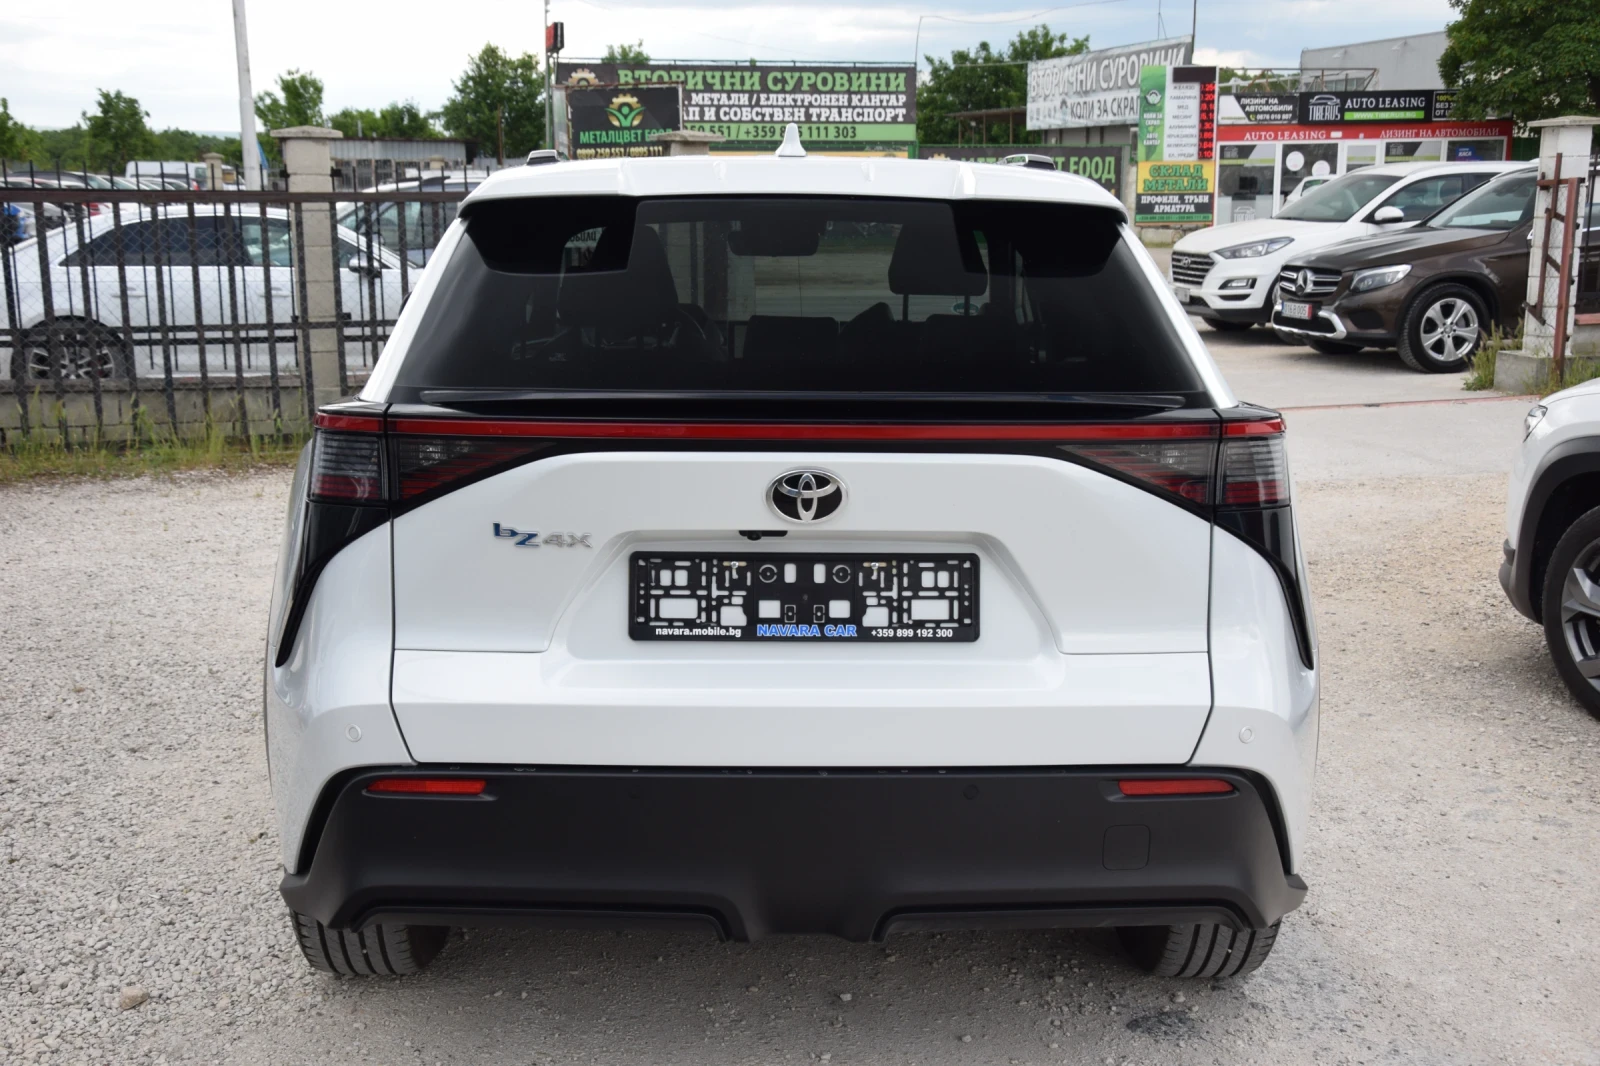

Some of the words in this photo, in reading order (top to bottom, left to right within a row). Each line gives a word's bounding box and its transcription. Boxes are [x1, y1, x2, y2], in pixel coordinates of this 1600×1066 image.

[617, 69, 761, 91] ВТОРИЧНИ
[766, 71, 907, 92] СУРОВИНИ
[1030, 61, 1097, 97] ВТОРИЧНИ
[691, 93, 749, 105] МЕТАЛИ
[751, 94, 757, 106] /
[759, 93, 849, 106] ЕЛЕКТРОНЕН
[851, 94, 907, 107] КАНТАР
[1344, 98, 1376, 109] AUTO
[1378, 97, 1426, 108] LEASING
[703, 107, 716, 121] И
[719, 107, 806, 121] СОБСТВЕН
[809, 107, 907, 122] ТРАНСПОРТ
[1070, 99, 1094, 121] КОЛИ
[1096, 100, 1109, 118] ЗА
[1308, 105, 1341, 121] TIBERUS
[579, 130, 643, 145] МЕТАЛЦВЕТ
[744, 126, 776, 139] +359
[779, 126, 803, 139] 85
[808, 126, 829, 139] 111
[834, 126, 857, 139] 303
[1244, 131, 1275, 141] AUTO
[1277, 131, 1327, 140] LEASING
[1380, 129, 1418, 138] ЛИЗИНГ
[1419, 129, 1433, 138] НА
[1435, 128, 1499, 137] АВТОМОБИЛИ
[1069, 156, 1116, 183] ЕООД
[1149, 164, 1204, 178] СКЛАД
[1143, 178, 1209, 192] МЕТАЛИ
[1140, 195, 1181, 204] ПРОФИЛИ,
[1183, 194, 1209, 203] ТРЪБИ
[1153, 204, 1196, 213] АРМАТУРА
[655, 627, 742, 638] navara.mobile.bg
[756, 624, 821, 637] NAVARA
[823, 624, 858, 637] CAR
[870, 628, 894, 638] +359
[896, 628, 914, 638] 899
[916, 628, 935, 638] 192
[935, 628, 953, 638] 300
